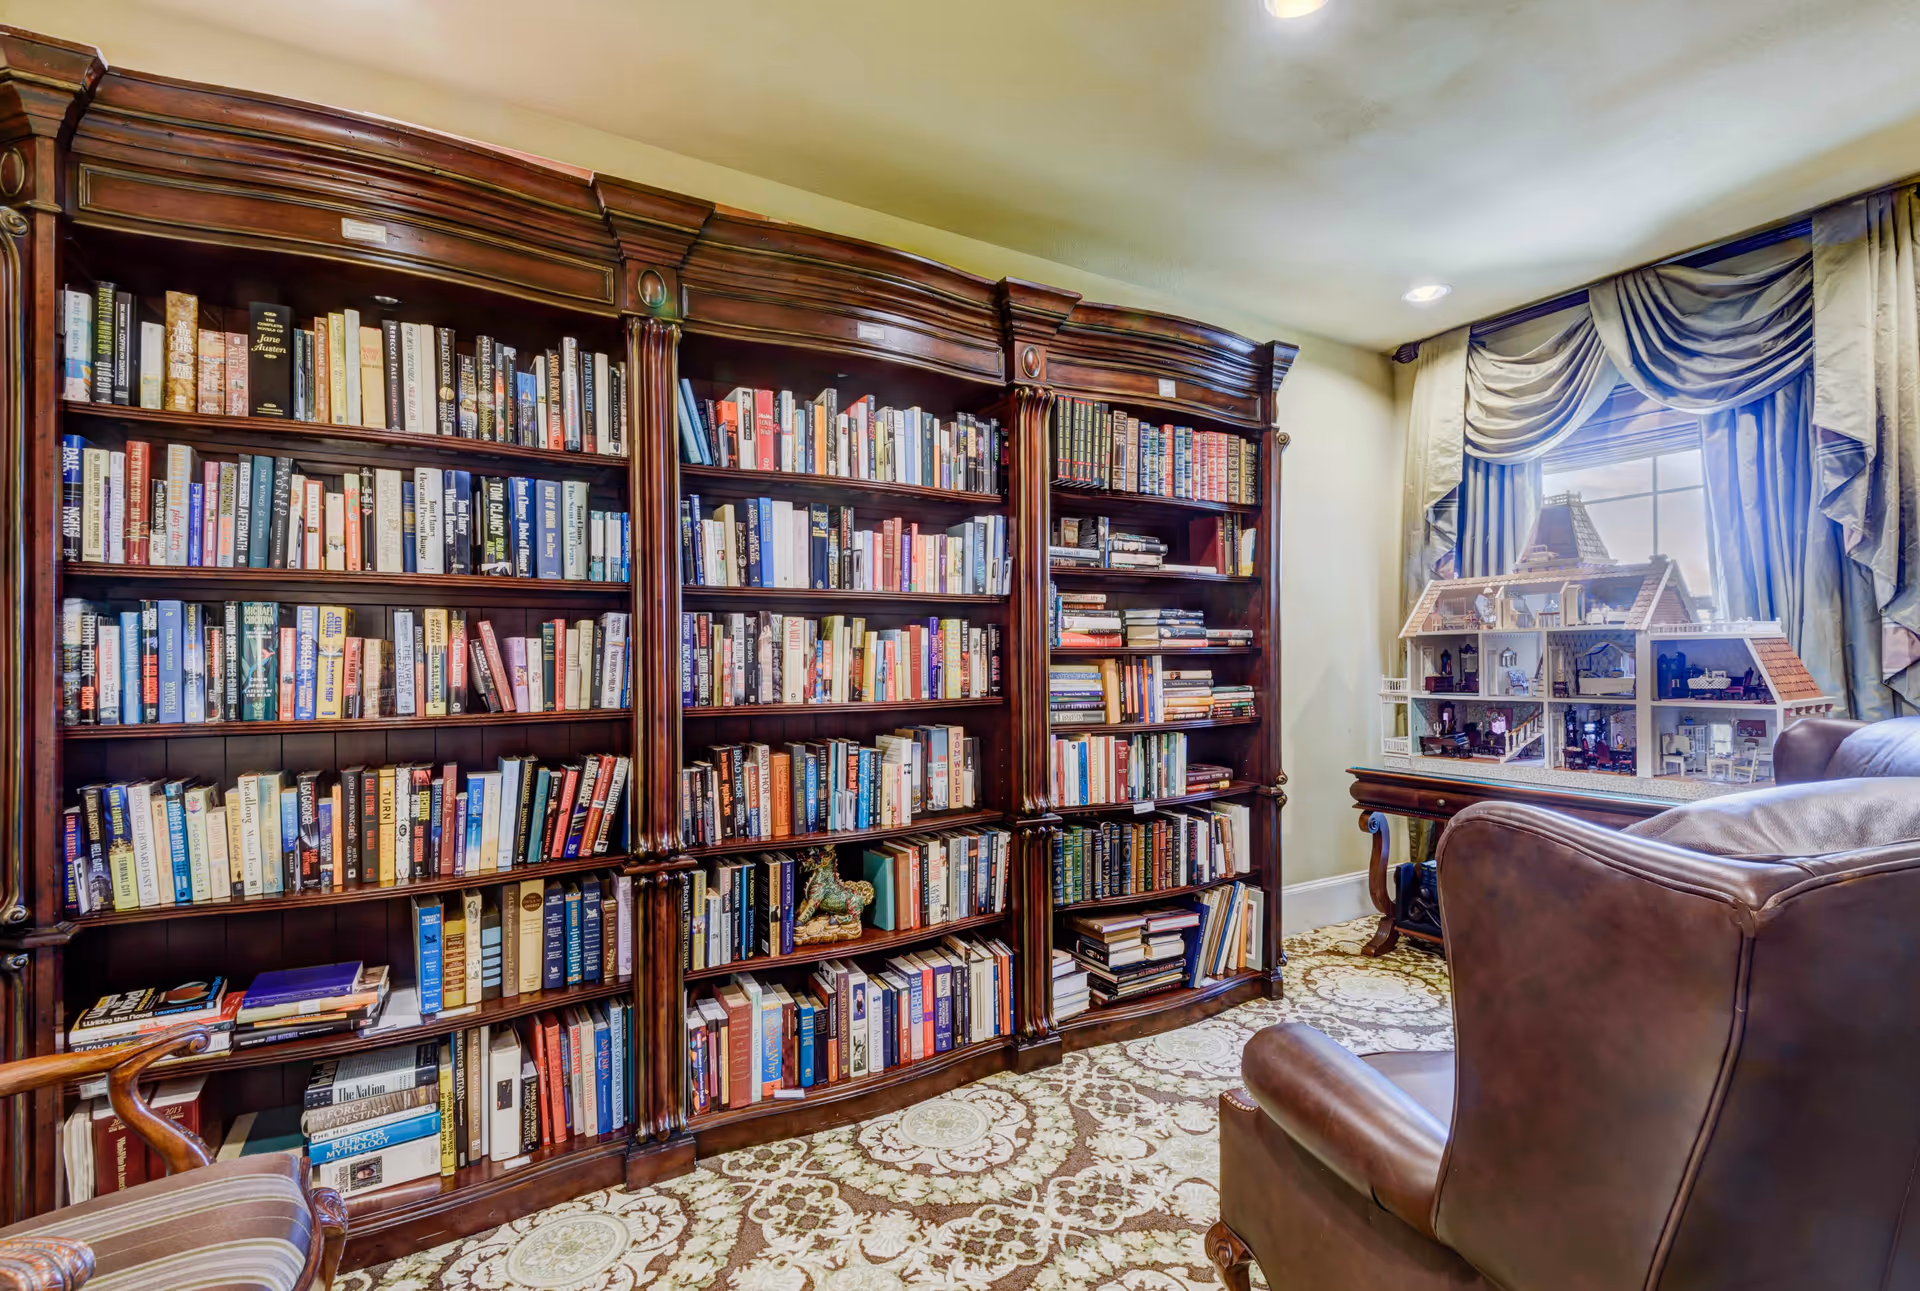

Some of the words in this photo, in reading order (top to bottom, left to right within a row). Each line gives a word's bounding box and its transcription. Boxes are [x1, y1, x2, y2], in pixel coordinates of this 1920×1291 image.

[98, 288, 111, 318] RUSSELL
[98, 320, 112, 355] ANDREWS
[251, 342, 287, 354] Austen
[256, 333, 281, 344] Jane
[389, 325, 398, 360] REBECCA'S
[229, 345, 237, 370] AUEL
[482, 338, 490, 363] STEVE
[95, 361, 114, 393] gideon
[390, 363, 398, 379] TALE
[482, 364, 491, 390] BERRY
[585, 361, 593, 389] PURCHASE
[439, 402, 448, 422] BERRY
[447, 403, 455, 422] STEVE
[552, 404, 560, 414] THE
[552, 414, 560, 436] WITNESS
[66, 448, 79, 470] DALE
[241, 464, 249, 482] LEVAR
[419, 473, 427, 490] Clear
[241, 483, 249, 506] BURTON
[275, 471, 283, 511] BONES
[280, 468, 289, 516] SACRED
[490, 483, 503, 501] TOM
[518, 481, 528, 495] Tom
[429, 500, 437, 514] Tom
[445, 488, 456, 515] Without
[458, 500, 469, 513] Tom
[516, 497, 529, 520] Clancy
[170, 509, 184, 528] play
[237, 508, 249, 550] AFTERMATH
[419, 507, 428, 534] Present
[428, 515, 436, 537] Clancy
[456, 513, 469, 535] Clancy
[490, 504, 504, 536] CLANCY
[445, 516, 456, 544] Remorse
[520, 522, 529, 539] Debt
[575, 521, 584, 545] Clancy
[170, 531, 184, 552] dirty
[419, 536, 427, 560] Danger
[487, 541, 495, 555] ALIVE
[520, 549, 529, 571] Honor
[82, 615, 95, 645] ROBIN
[326, 612, 334, 638] CUSSLER
[334, 616, 342, 634] CLIVE
[82, 649, 95, 677] COOK
[165, 682, 176, 713] PREDATOR
[406, 688, 411, 696] OF
[733, 749, 741, 772] BRAD
[525, 762, 533, 785] THOMAS
[807, 775, 815, 792] THOR
[110, 789, 120, 806] LINDA
[301, 781, 312, 795] LISA
[523, 785, 531, 804] HARRIS
[603, 784, 620, 814] HIGGINS
[86, 794, 96, 812] LINDA
[301, 795, 313, 824] GARDNER
[112, 807, 123, 835] FAIRSTEIN
[168, 798, 181, 831] TRIGGER
[520, 808, 528, 834] HANNIBAL
[88, 813, 98, 840] FAIRSTEIN
[91, 843, 102, 858] HELL
[172, 833, 185, 862] MORTIS
[193, 830, 201, 851] LOOSE
[518, 836, 526, 853] RISING
[92, 860, 102, 872] GATE
[194, 853, 202, 872] ENDS
[302, 852, 310, 875] NOTHING
[310, 849, 318, 863] FEAR
[118, 856, 128, 884] TERMINAL
[121, 885, 130, 897] CITY
[82, 1018, 112, 1027] Writing
[129, 1011, 152, 1020] Novel
[154, 1006, 185, 1016] Lawrence
[585, 1053, 594, 1067] The
[601, 1038, 609, 1080] AMERICA
[763, 1052, 778, 1078] Why?
[338, 1088, 354, 1102] The
[356, 1084, 385, 1100] Nation
[585, 1070, 595, 1111] Hawaiians
[326, 1136, 389, 1159] MYTHOLOGY
[332, 1130, 384, 1150] BULFINCH'S
